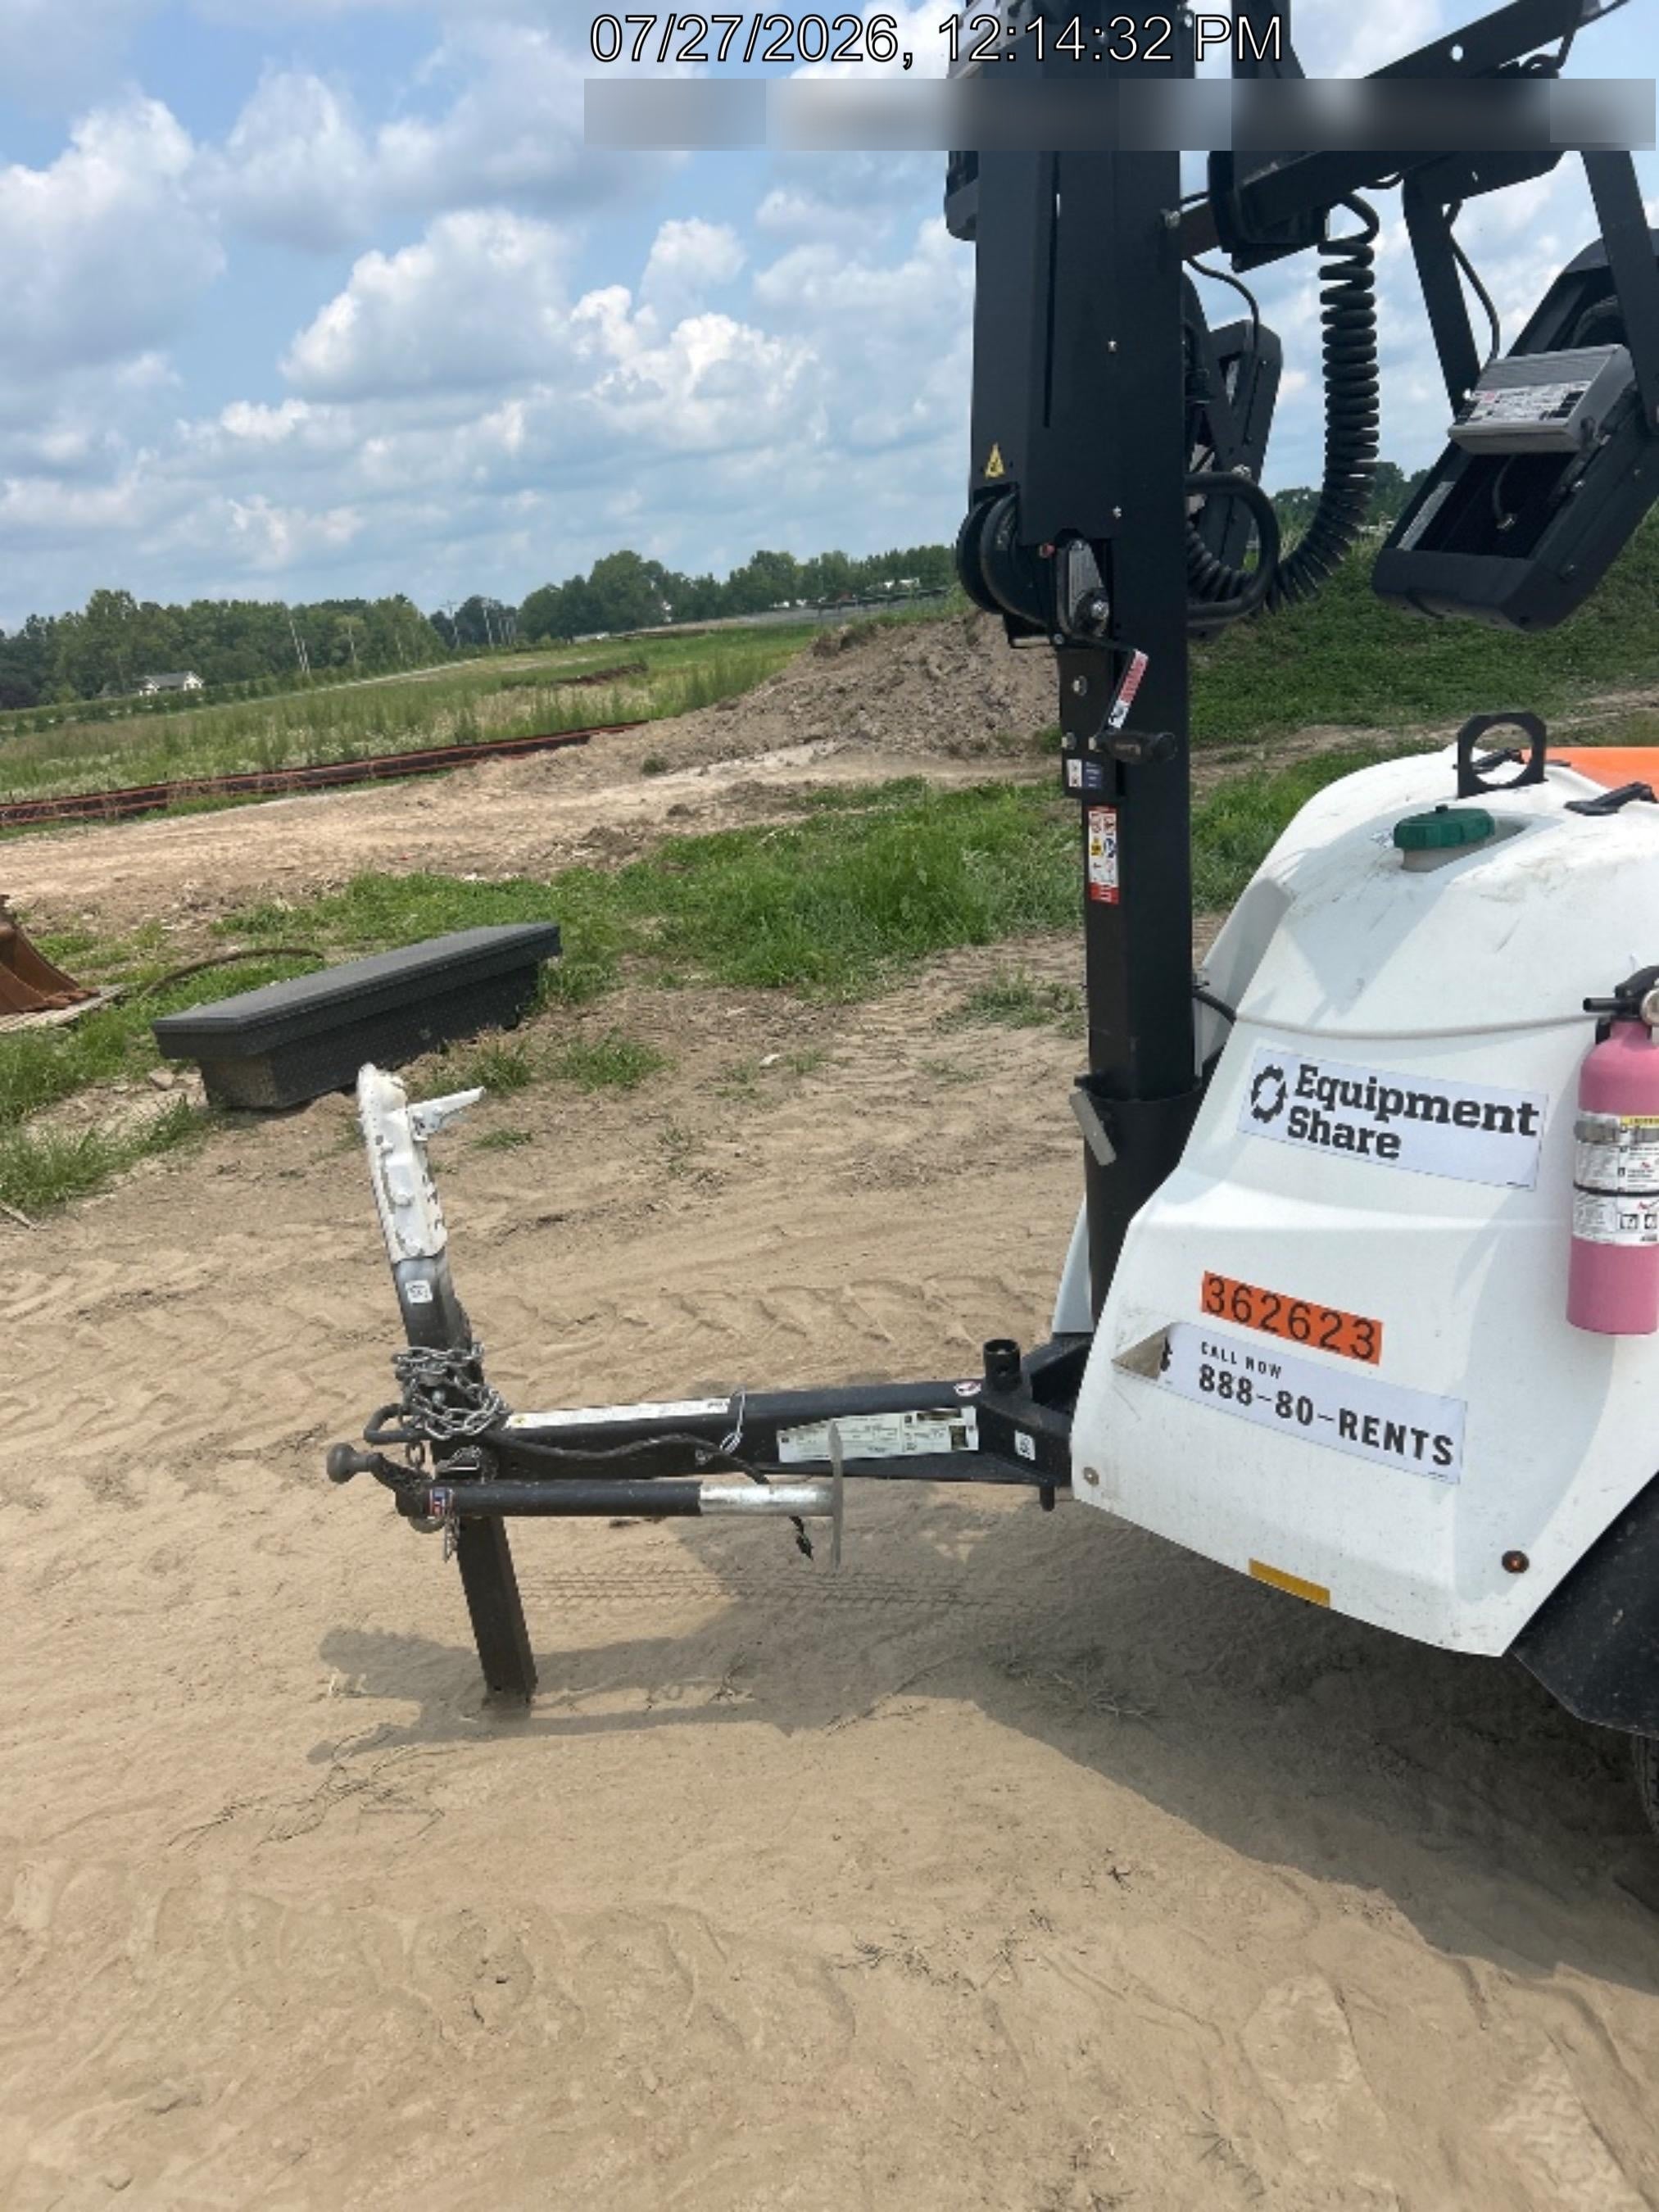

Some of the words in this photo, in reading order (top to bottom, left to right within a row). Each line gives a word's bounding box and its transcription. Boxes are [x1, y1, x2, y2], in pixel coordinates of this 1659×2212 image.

[1287, 1105, 1401, 1159] Share
[1294, 1063, 1539, 1136] Equipment
[1205, 1275, 1376, 1361] 362623
[1200, 1341, 1238, 1365] CALL
[1245, 1356, 1282, 1380] NOW
[1199, 1363, 1454, 1466] 888-80-RENTS
